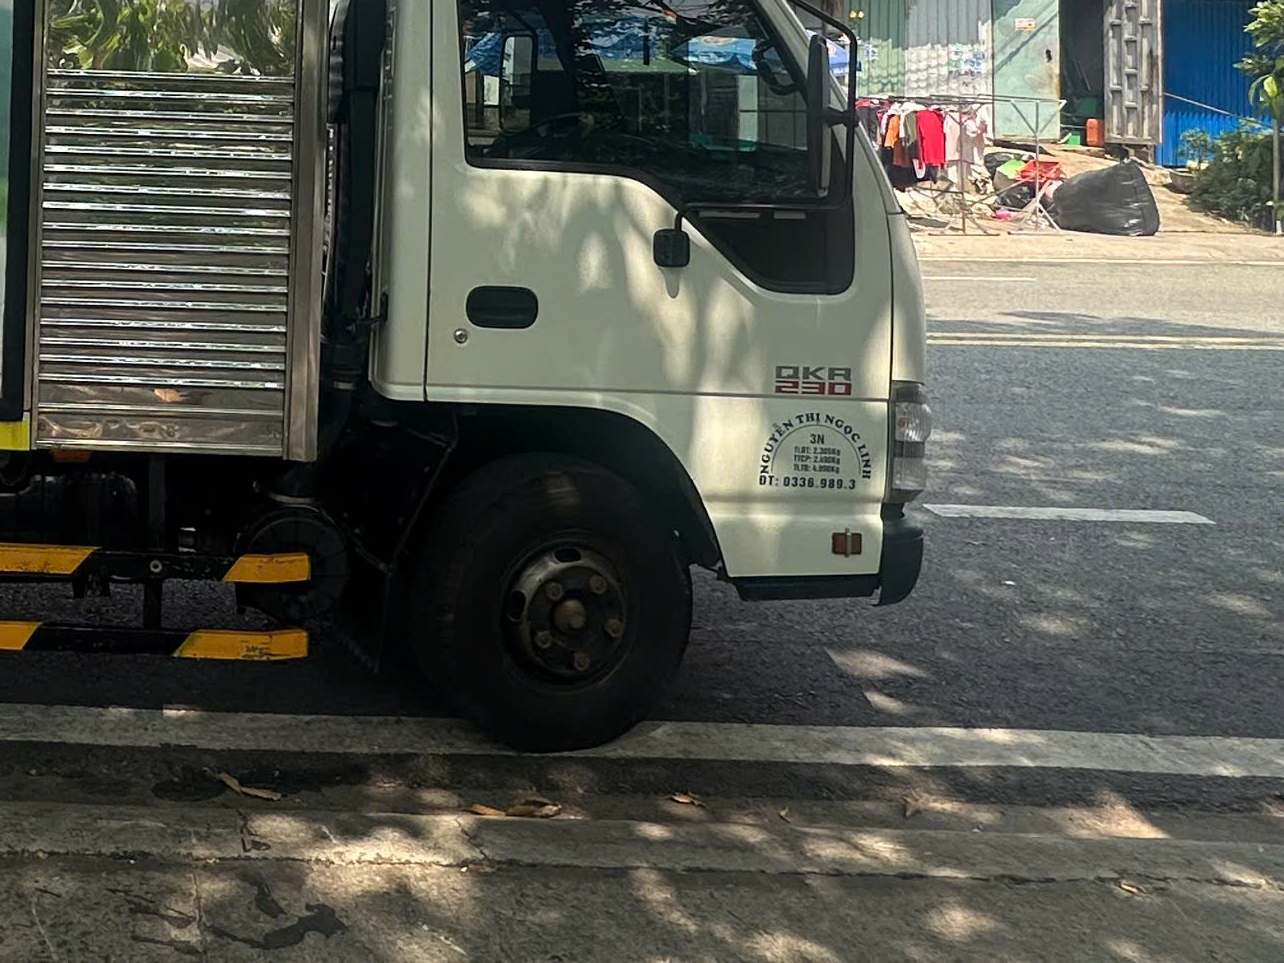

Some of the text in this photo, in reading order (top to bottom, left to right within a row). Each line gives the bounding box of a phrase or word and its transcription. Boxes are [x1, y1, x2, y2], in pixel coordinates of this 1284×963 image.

[775, 365, 851, 381] QKR
[775, 380, 852, 395] 230
[810, 433, 825, 445] 3N
[759, 419, 794, 475] NGUYỄN
[857, 443, 872, 480] LINH
